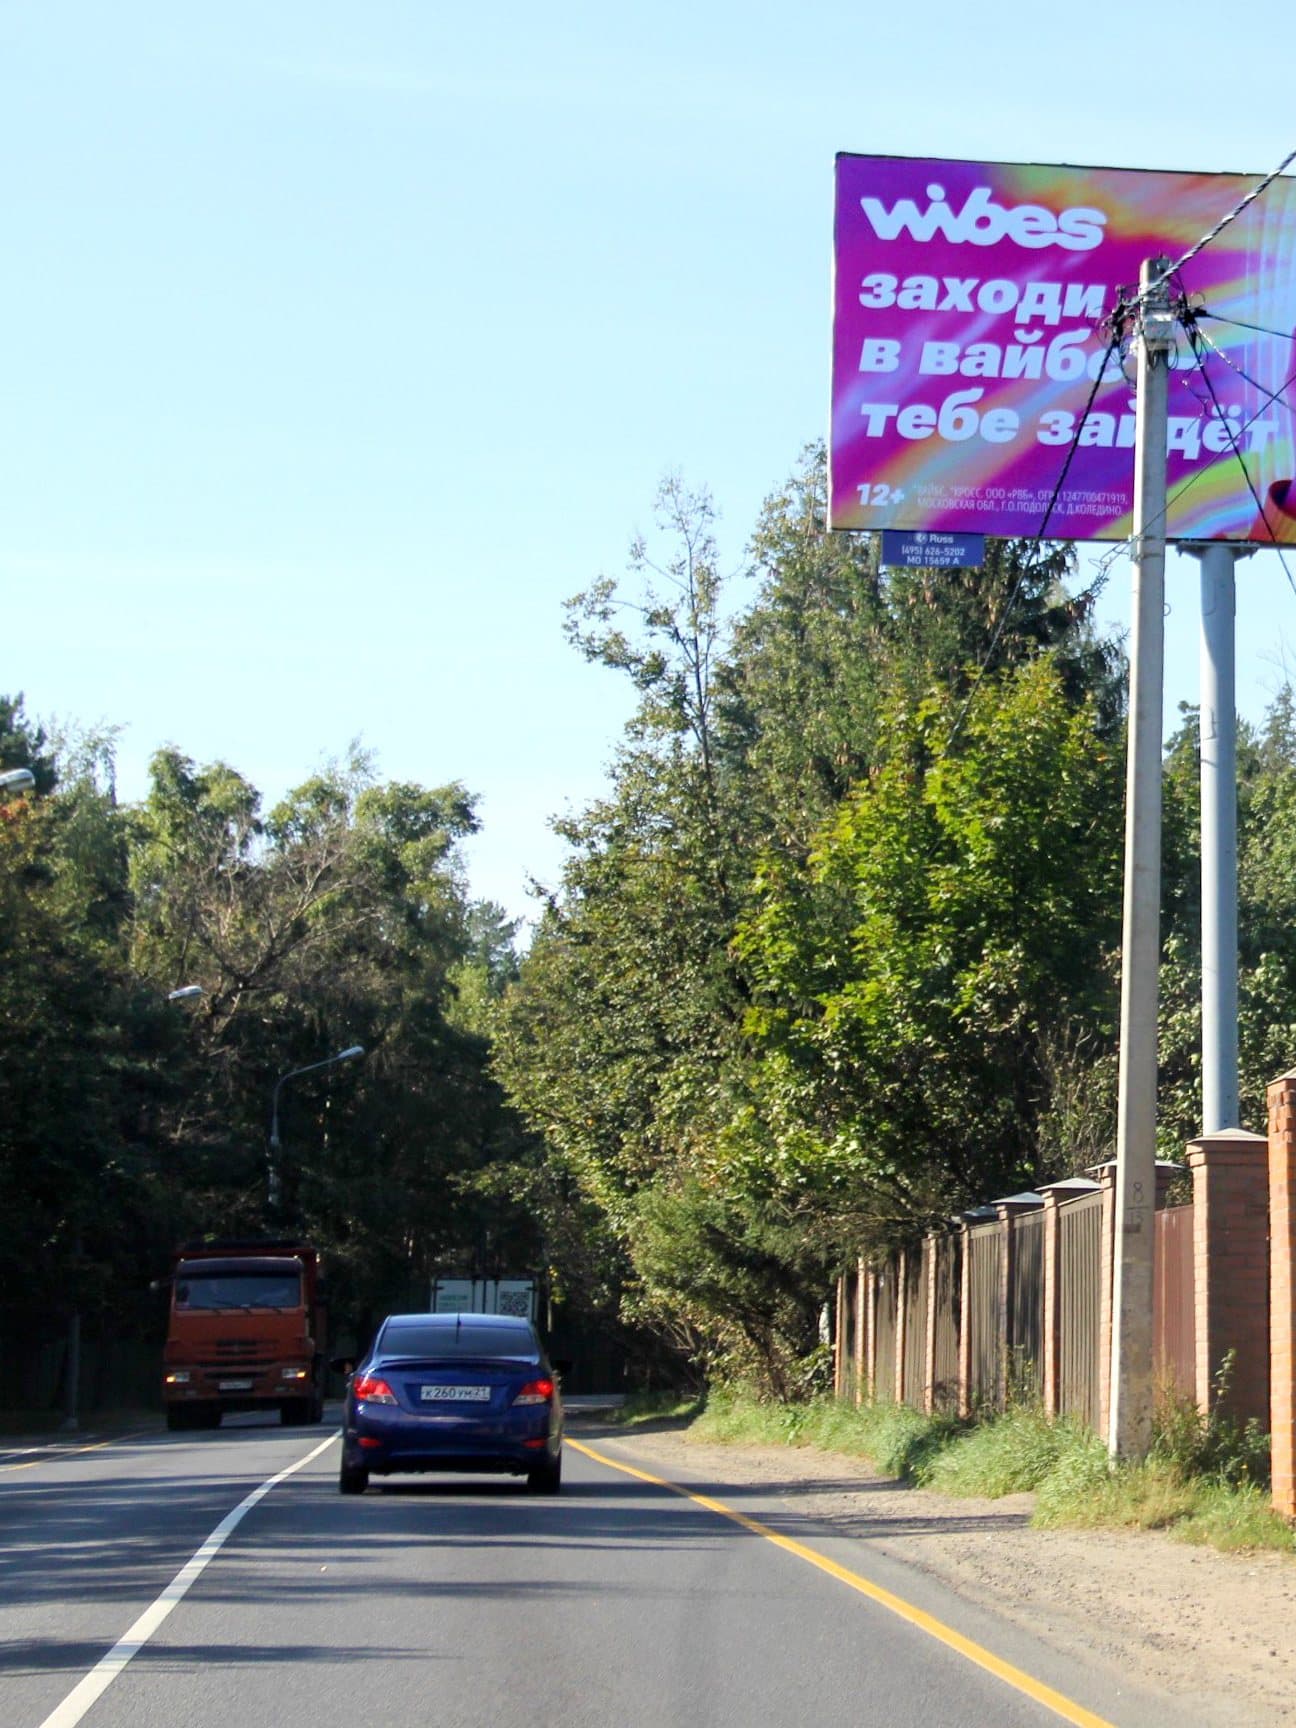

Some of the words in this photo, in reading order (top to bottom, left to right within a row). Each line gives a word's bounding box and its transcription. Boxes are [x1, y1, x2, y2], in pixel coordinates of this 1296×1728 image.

[860, 183, 1107, 251] wibes
[859, 273, 1107, 326] заходи
[859, 338, 901, 373] в
[861, 387, 1020, 443] тебе
[856, 483, 905, 507] 12+
[929, 533, 954, 544] Russ
